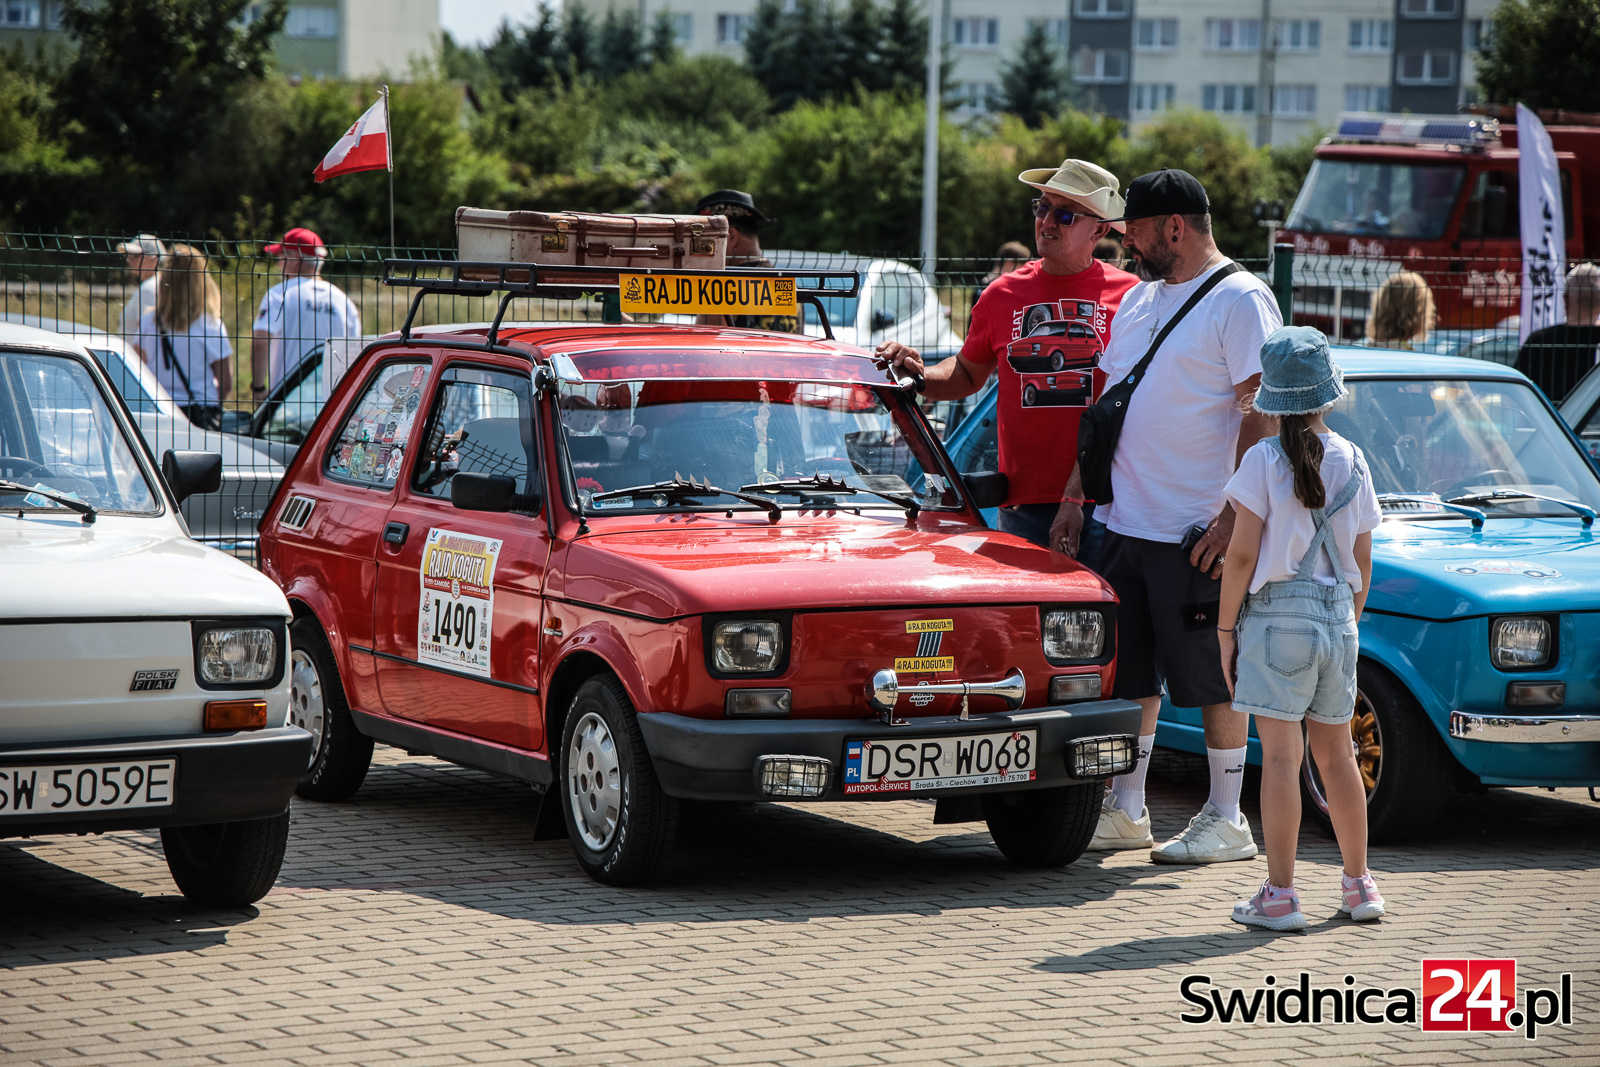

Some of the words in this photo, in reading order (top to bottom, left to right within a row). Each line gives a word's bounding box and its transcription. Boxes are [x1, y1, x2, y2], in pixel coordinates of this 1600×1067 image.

[644, 277, 693, 304] RAJD
[698, 278, 773, 306] KOGUTA
[775, 281, 792, 291] 2026
[1011, 309, 1023, 340] FIAT
[1096, 303, 1108, 334] 126P
[428, 548, 452, 579] RAJD
[450, 552, 487, 588] KOGUTA
[432, 598, 476, 650] 1490
[912, 621, 927, 630] RAJD
[926, 620, 947, 630] KOGUTA
[902, 660, 920, 670] RAJD
[920, 659, 946, 669] KOGUTA
[137, 671, 178, 680] POLSKI
[134, 679, 175, 690] FIAT
[868, 742, 943, 779] DSR
[847, 767, 859, 777] PL
[51, 764, 170, 808] 5059E
[846, 781, 909, 793] AUTOPOL-SERVICE
[914, 780, 935, 789] Środa
[949, 778, 977, 787] Ciechów
